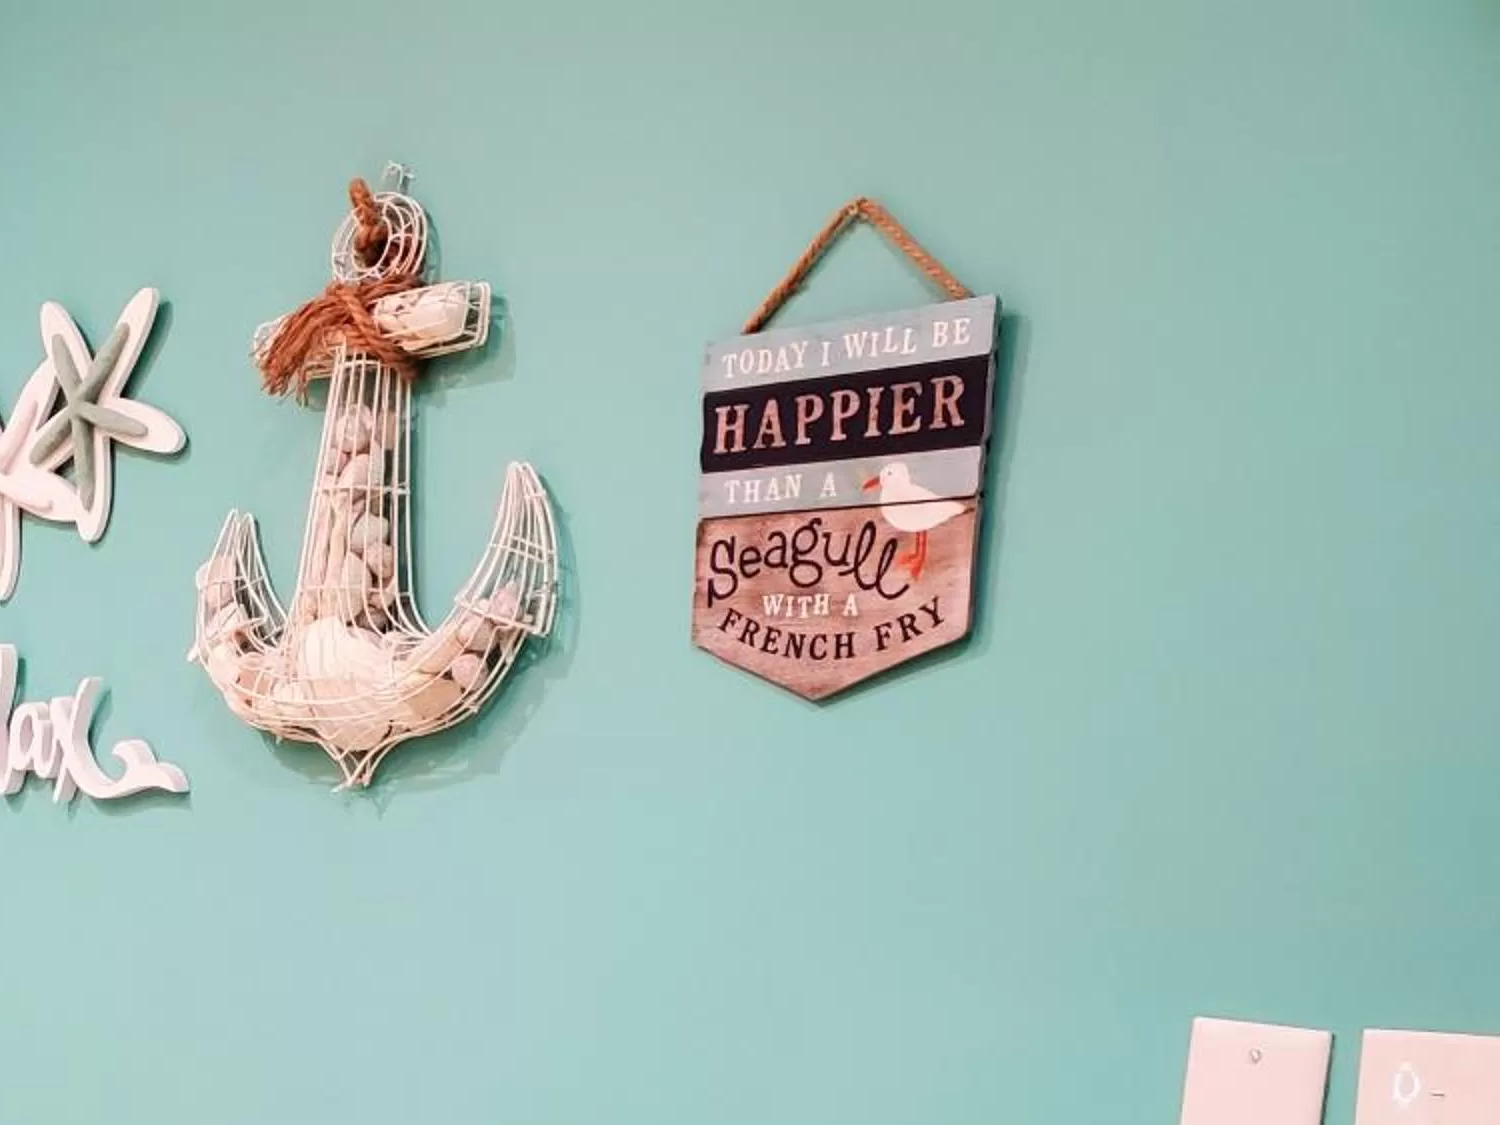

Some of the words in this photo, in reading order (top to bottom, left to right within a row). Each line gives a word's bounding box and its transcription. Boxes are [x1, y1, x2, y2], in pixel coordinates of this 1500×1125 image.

[722, 341, 807, 378] TODAY
[820, 341, 831, 368] I
[843, 327, 917, 363] WILL
[930, 317, 972, 348] BE
[713, 374, 966, 455] HAPPIER
[724, 474, 801, 504] THAN
[819, 473, 837, 498] A
[707, 517, 909, 608] Seagull
[717, 608, 856, 660] FRENCH
[875, 597, 945, 653] FRY
[762, 592, 831, 618] WITH
[842, 590, 859, 617] A
